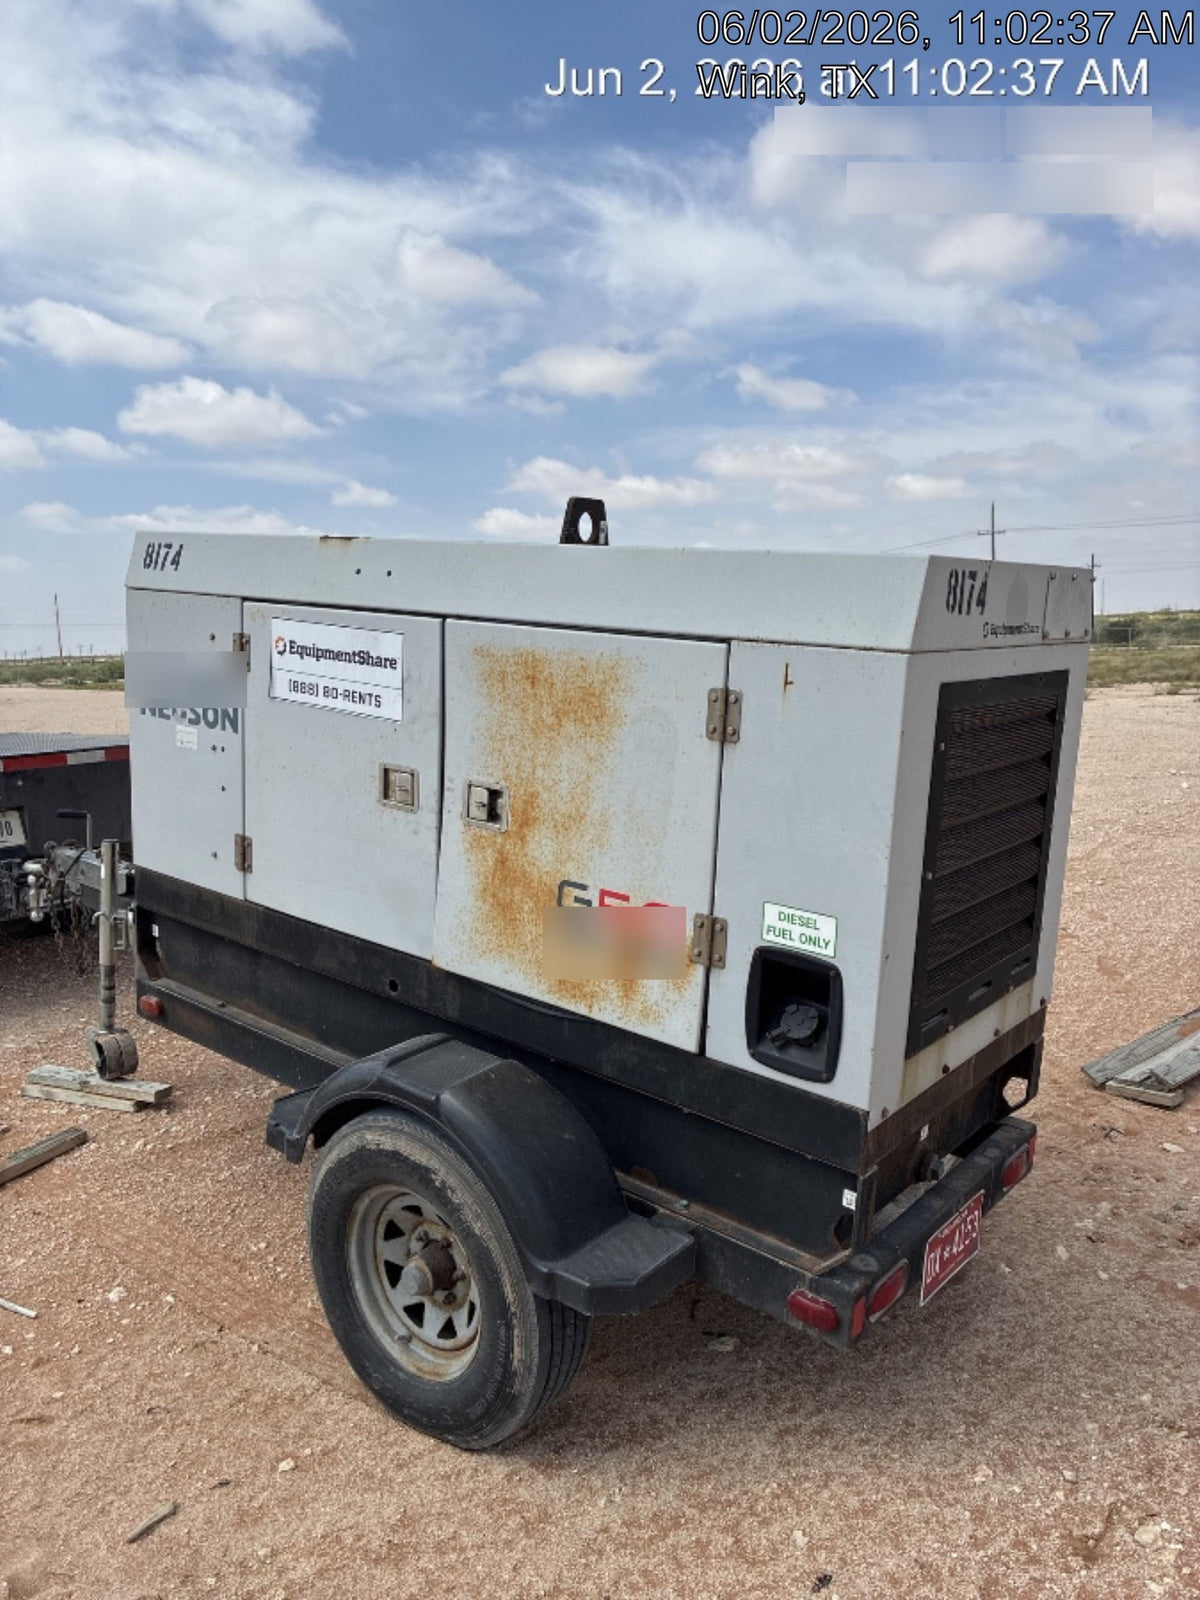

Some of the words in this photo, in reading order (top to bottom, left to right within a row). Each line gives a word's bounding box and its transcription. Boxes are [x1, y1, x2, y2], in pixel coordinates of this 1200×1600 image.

[143, 541, 184, 571] 8174
[946, 569, 988, 615] 8174
[289, 639, 398, 670] EquipmentShare
[288, 678, 319, 698] (888)
[778, 911, 820, 931] DIESEL
[766, 924, 795, 942] FUEL
[799, 932, 832, 950] ONLY
